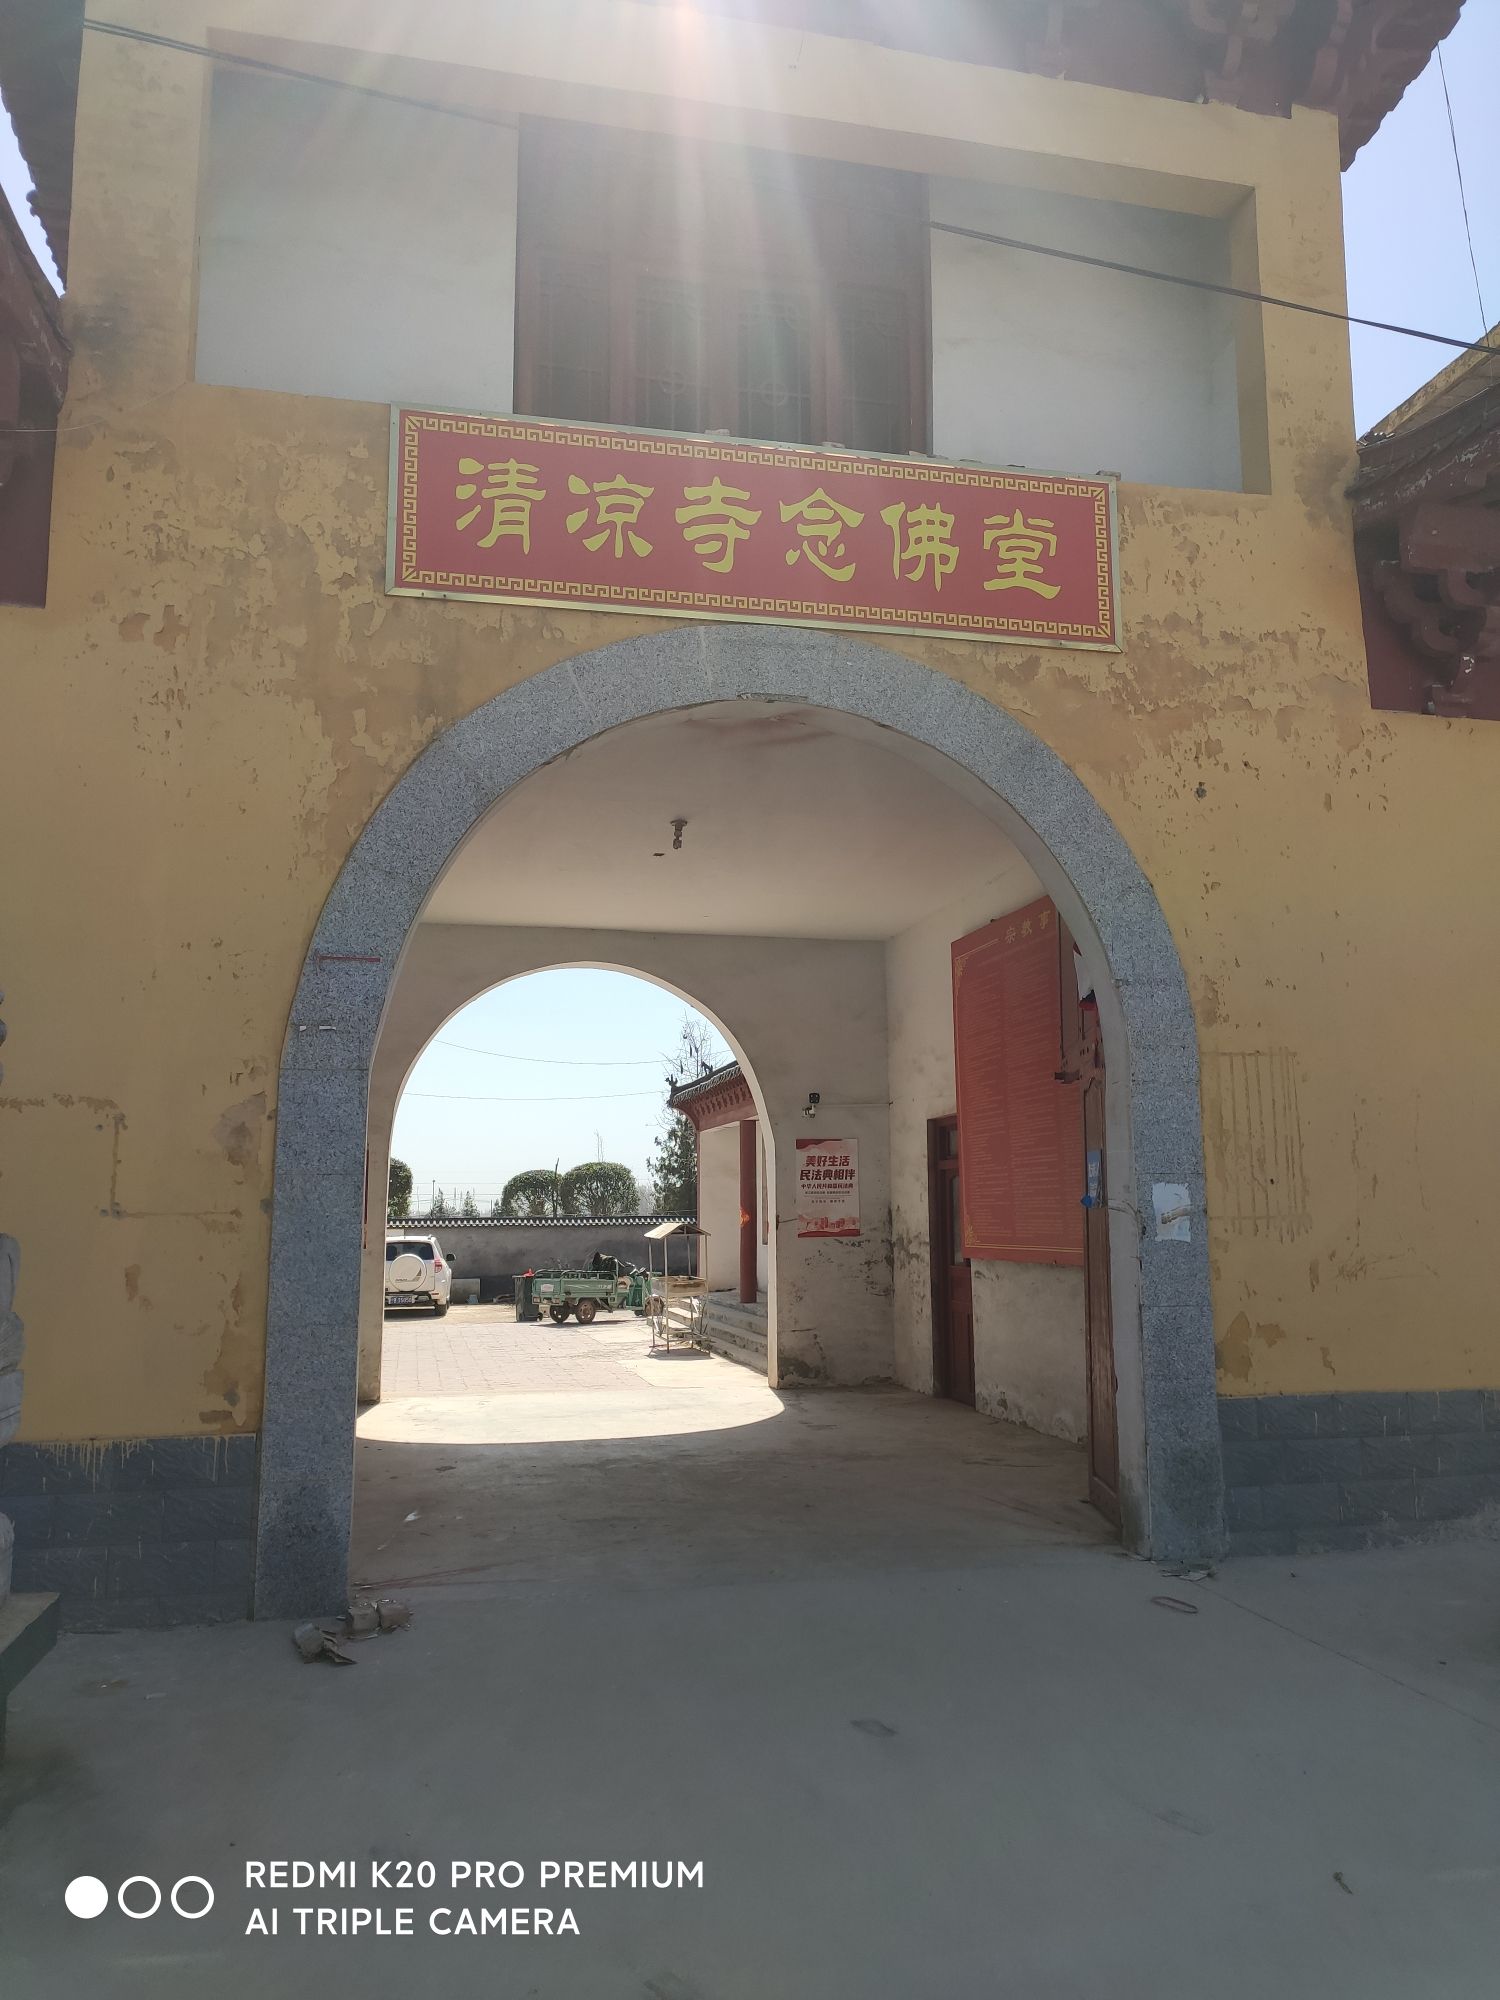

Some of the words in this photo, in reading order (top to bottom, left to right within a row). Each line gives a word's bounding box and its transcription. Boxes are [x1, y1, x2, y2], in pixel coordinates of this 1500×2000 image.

[455, 456, 1061, 600] 清凉寺念佛堂
[805, 1155, 851, 1167] 美好生活
[800, 1168, 856, 1181] 民法典相伴
